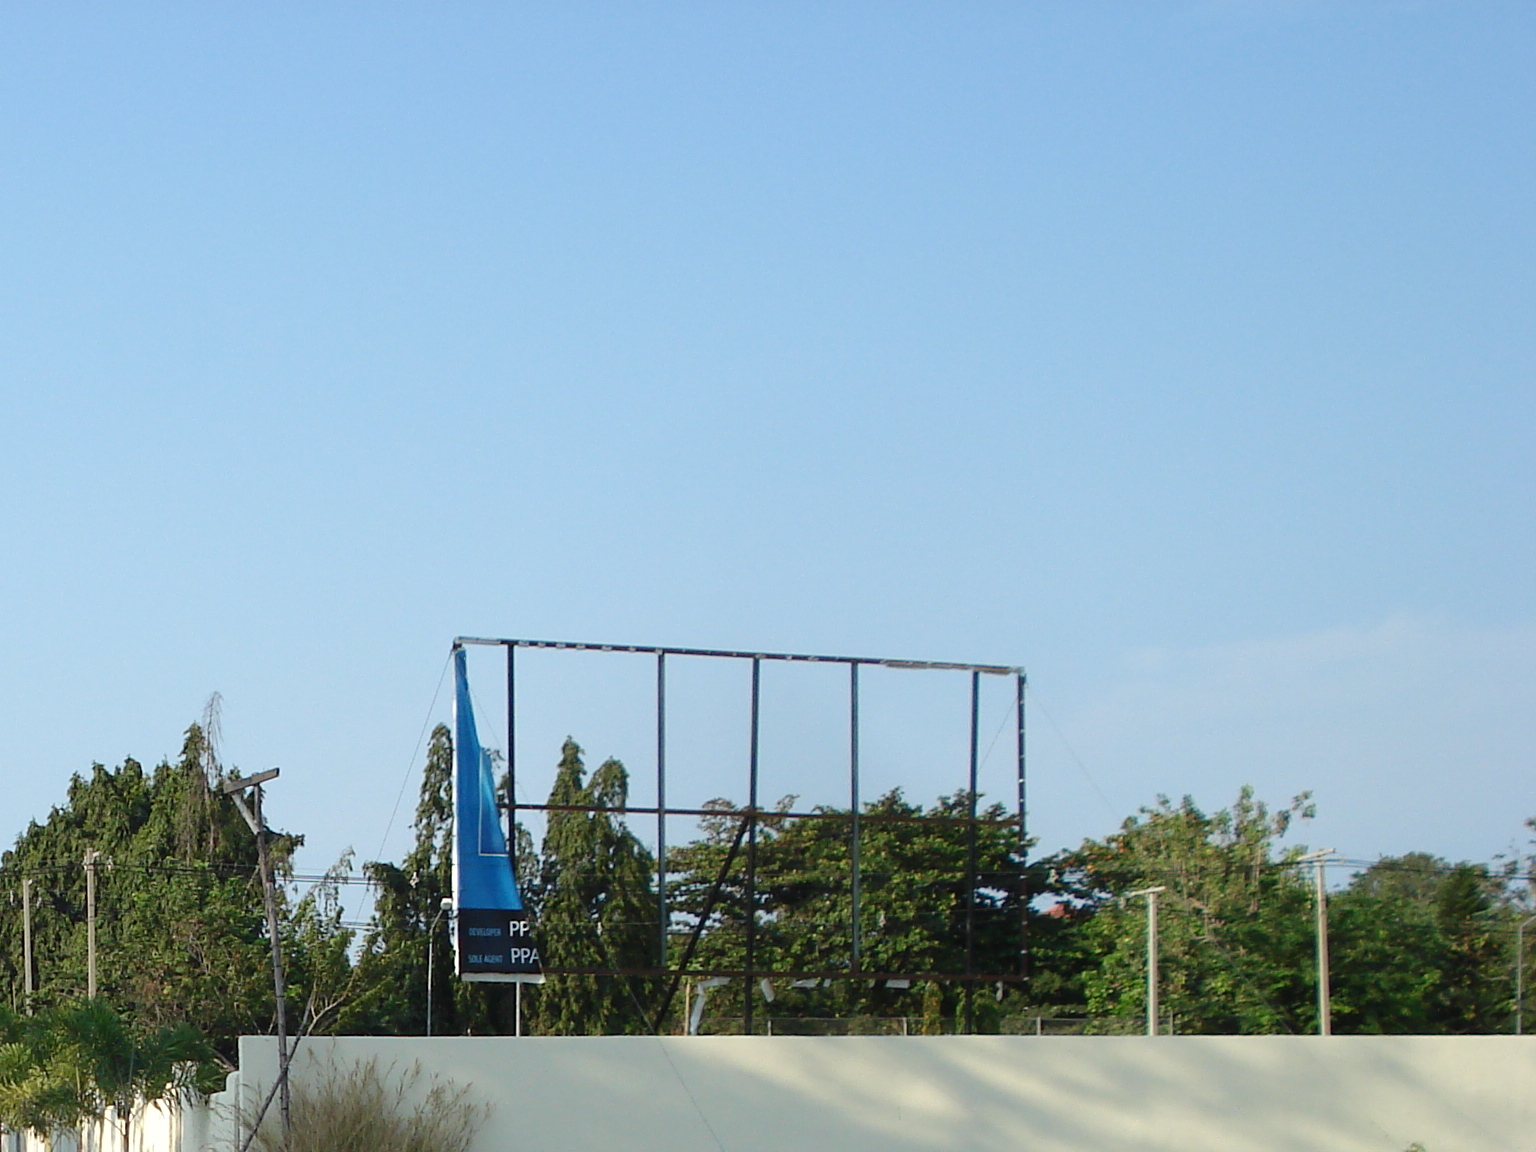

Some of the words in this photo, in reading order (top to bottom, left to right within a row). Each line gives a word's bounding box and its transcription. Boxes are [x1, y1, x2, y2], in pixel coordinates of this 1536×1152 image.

[468, 928, 501, 936] DEVELOPER
[468, 954, 483, 963] SOLE
[484, 954, 503, 963] AGENT
